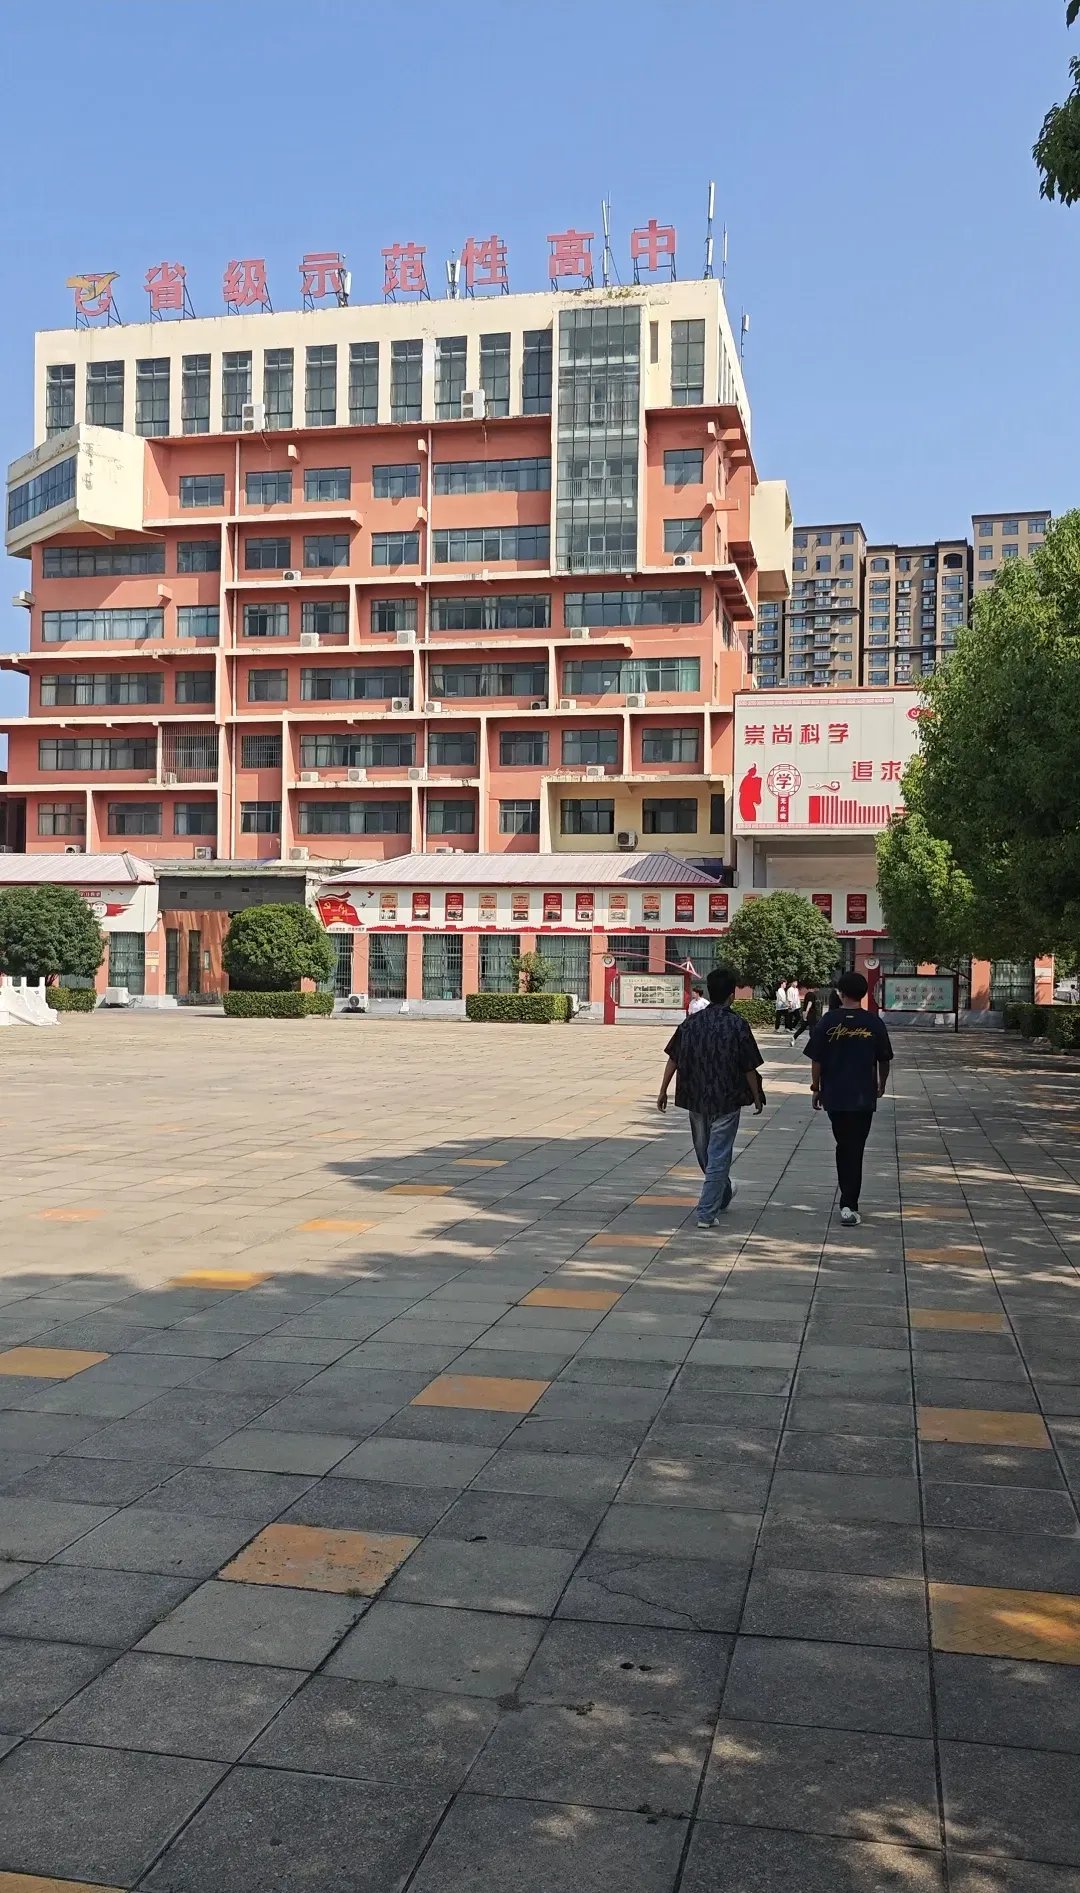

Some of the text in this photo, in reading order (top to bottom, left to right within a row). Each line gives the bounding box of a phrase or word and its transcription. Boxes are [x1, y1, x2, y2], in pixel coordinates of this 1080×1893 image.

[143, 219, 677, 311] 省级示范性高中
[744, 723, 850, 745] 崇尚科学
[851, 760, 903, 783] 追求
